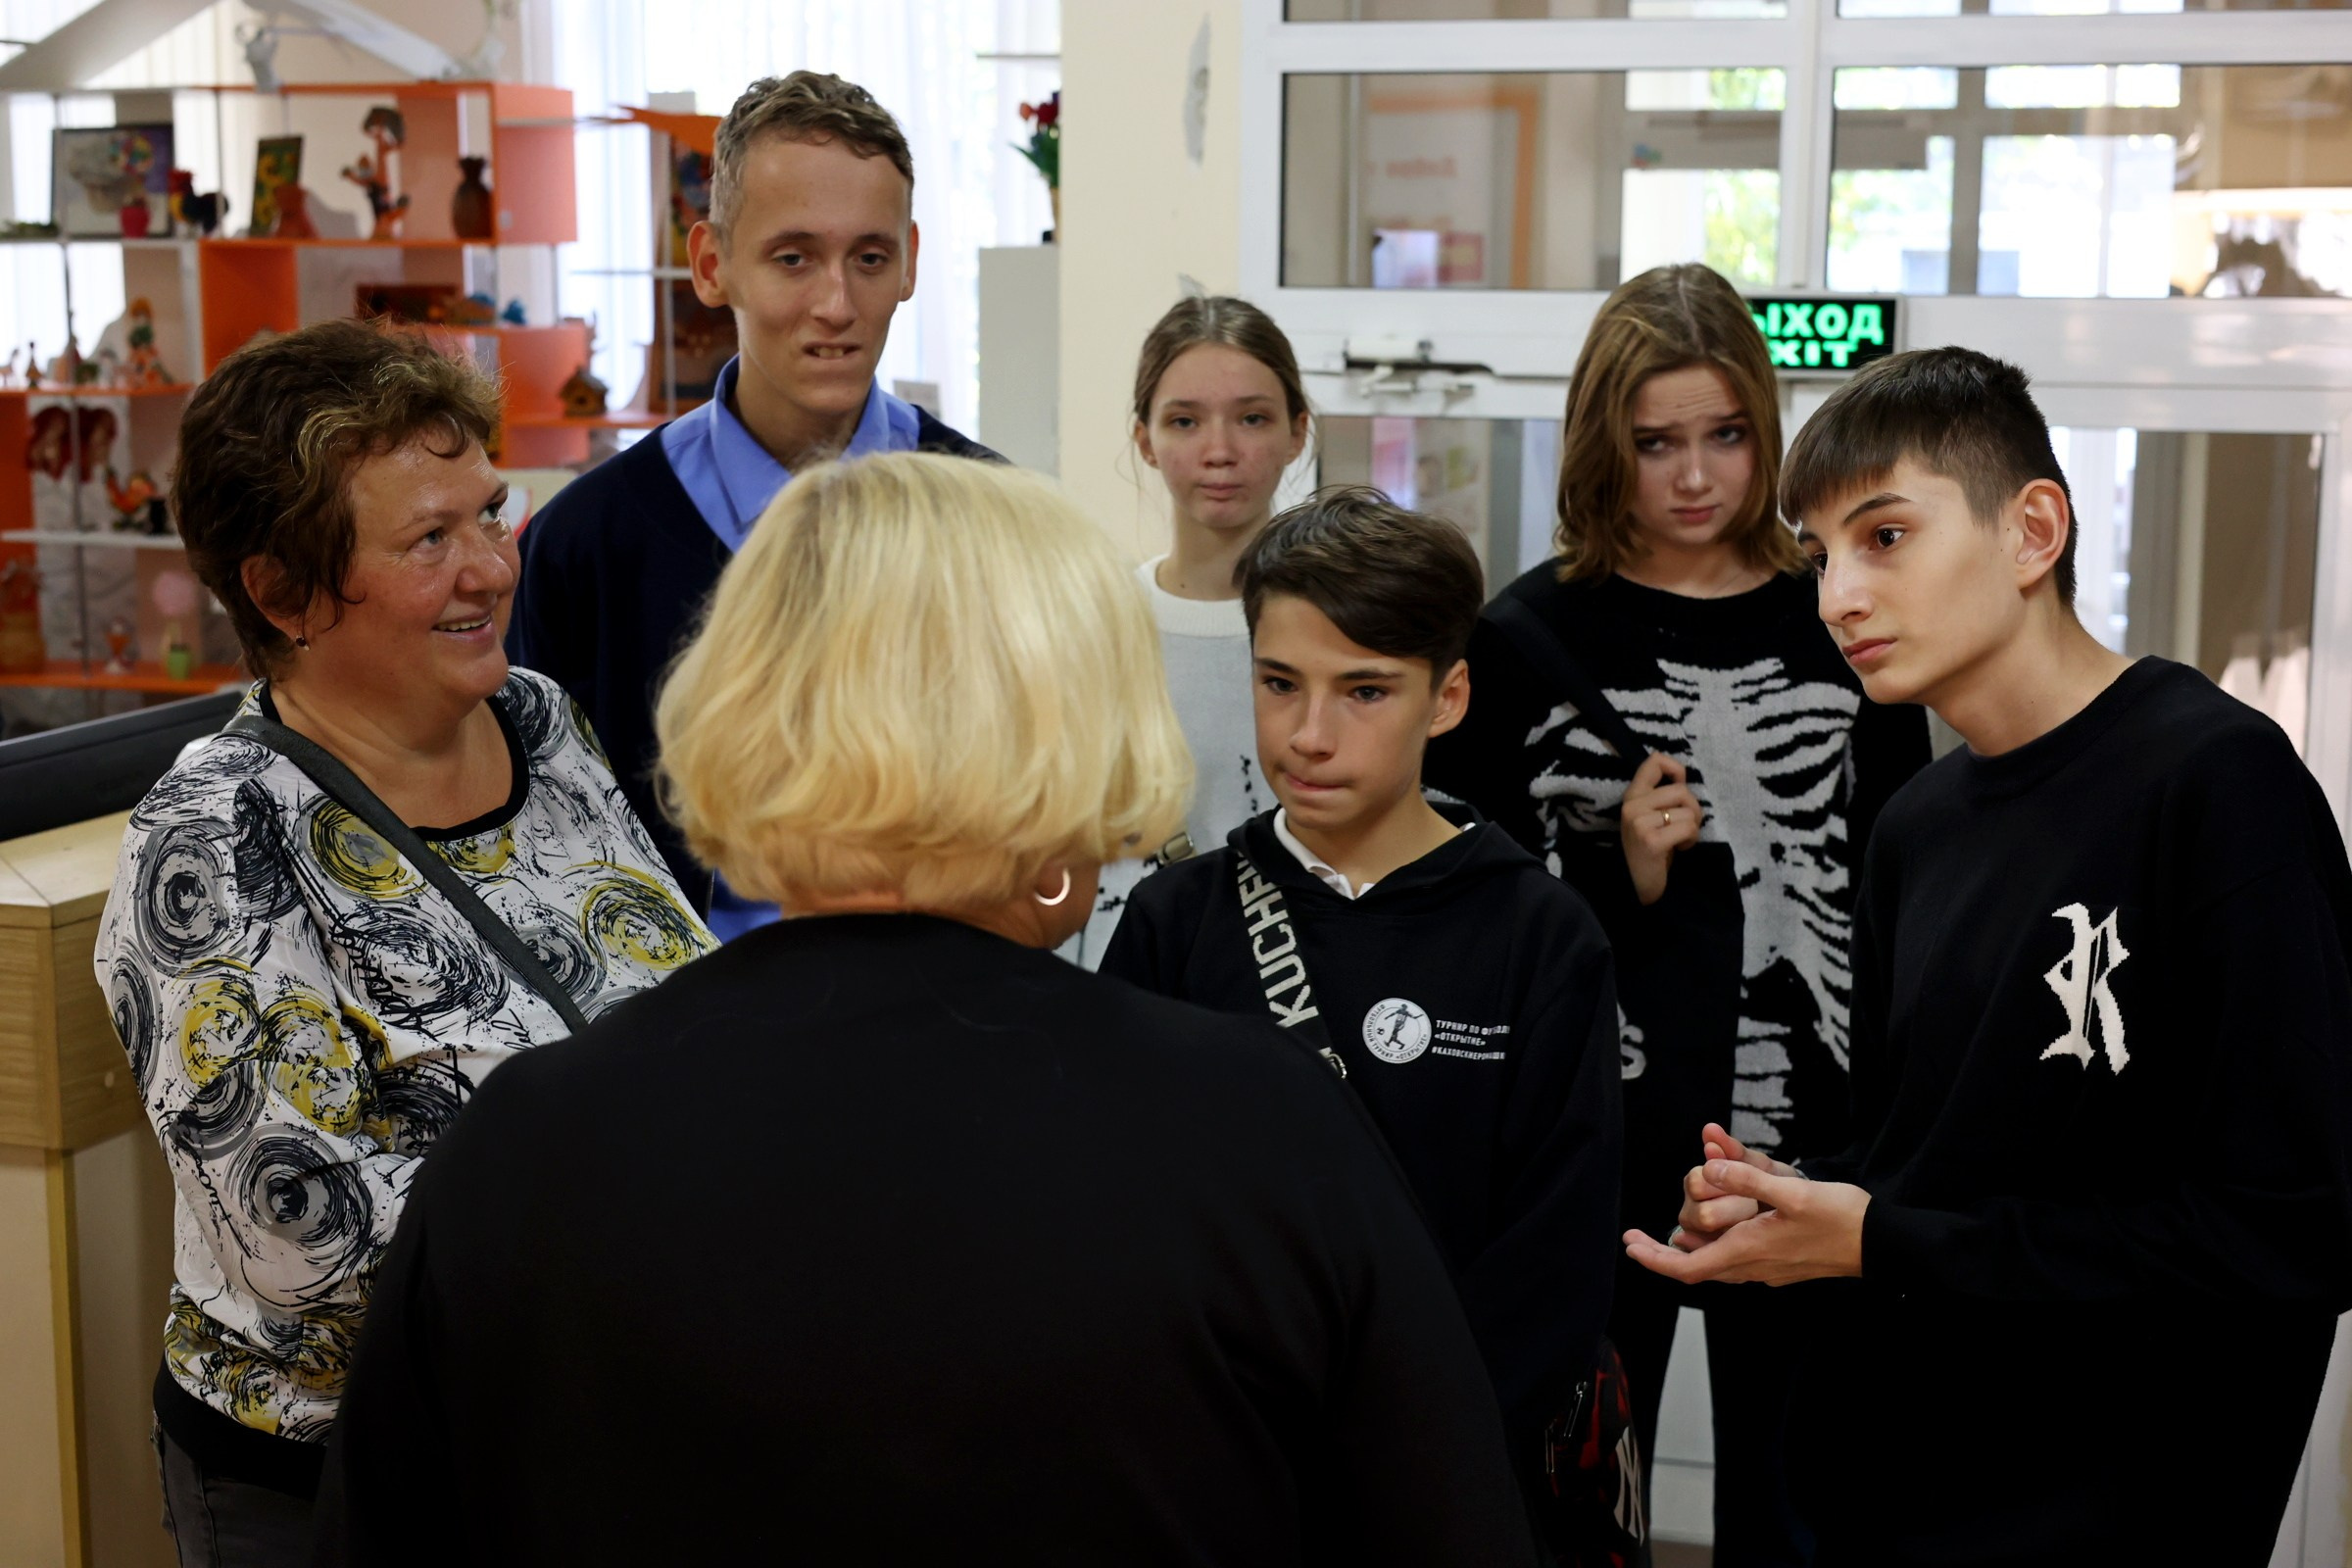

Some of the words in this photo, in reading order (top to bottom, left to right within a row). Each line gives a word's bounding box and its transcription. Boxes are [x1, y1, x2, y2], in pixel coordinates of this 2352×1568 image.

[1747, 303, 1884, 345] ЫХОД
[1768, 339, 1857, 367] XIT
[1436, 1019, 1468, 1032] ТУРНИР
[1469, 1024, 1480, 1034] ПО
[1434, 1032, 1487, 1046] «ОТКРЫТИЕ»
